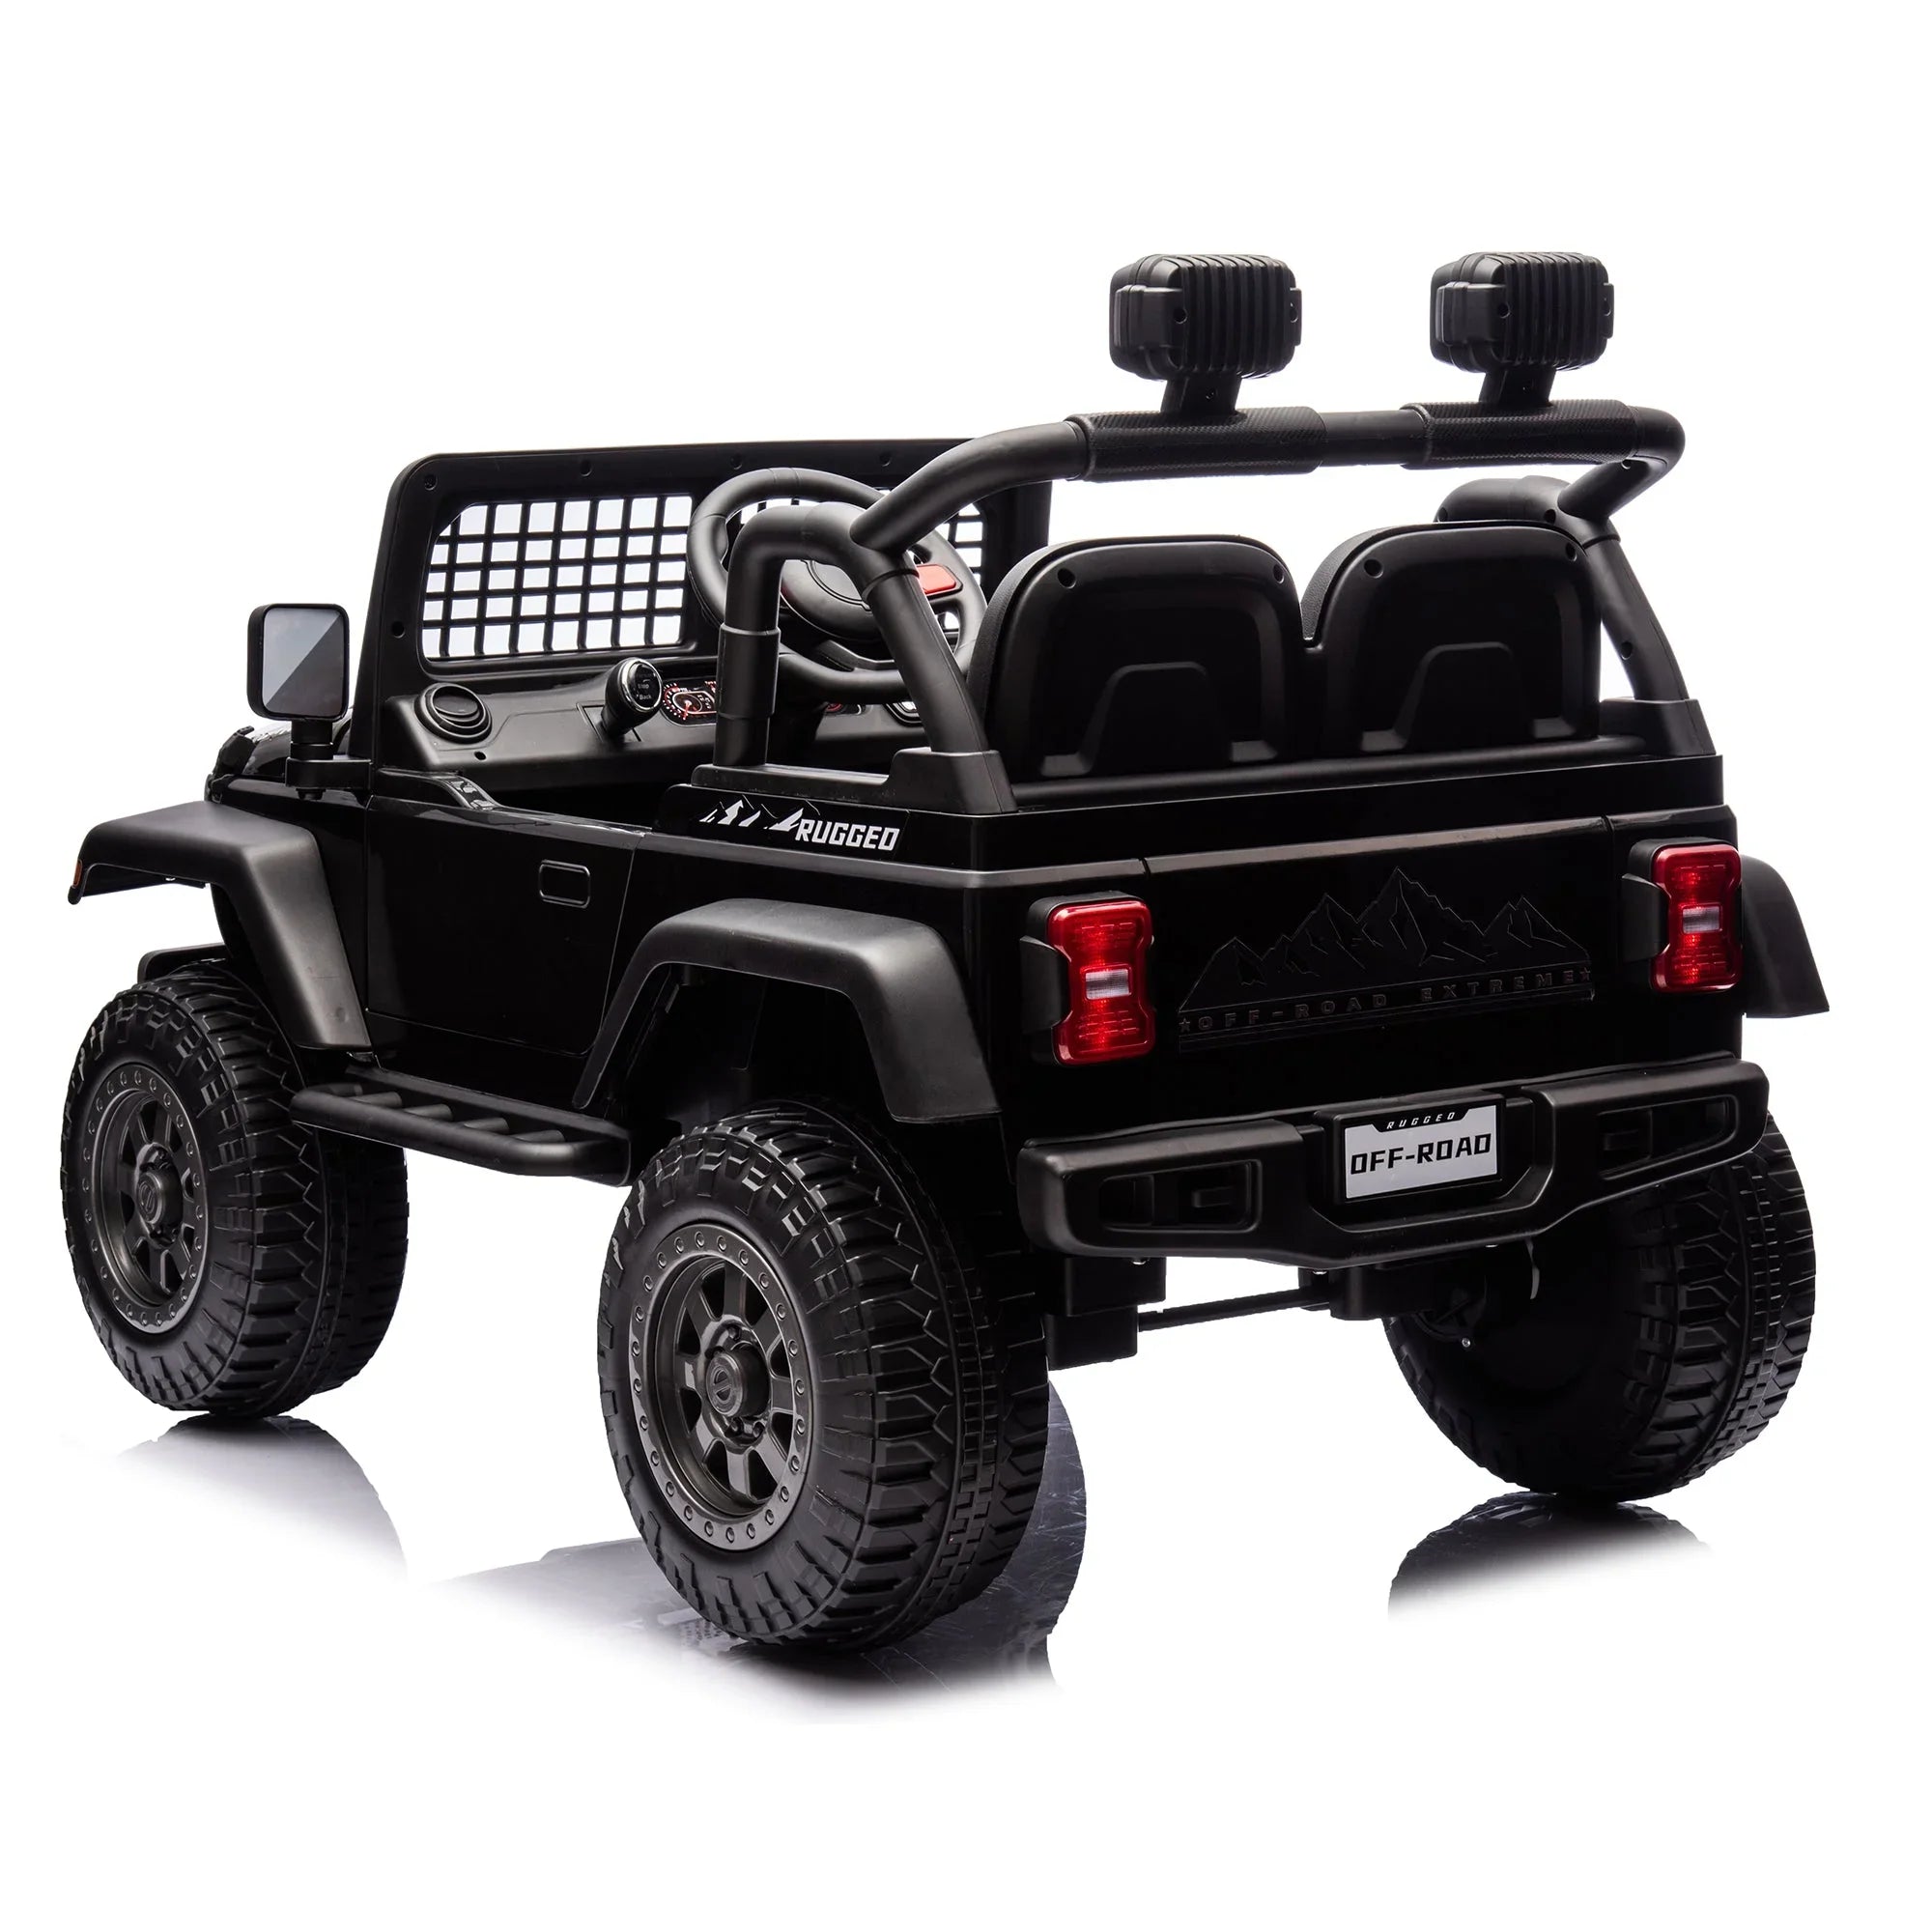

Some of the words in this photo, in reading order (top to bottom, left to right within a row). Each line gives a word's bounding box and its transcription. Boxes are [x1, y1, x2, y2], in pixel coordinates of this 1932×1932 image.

[794, 817, 901, 852] RUGGED
[1198, 993, 1387, 1032] OFF-ROAD
[1420, 969, 1575, 1003] EXTREME
[1385, 1110, 1457, 1131] RUGGED
[1350, 1132, 1492, 1175] OFF-ROAD
